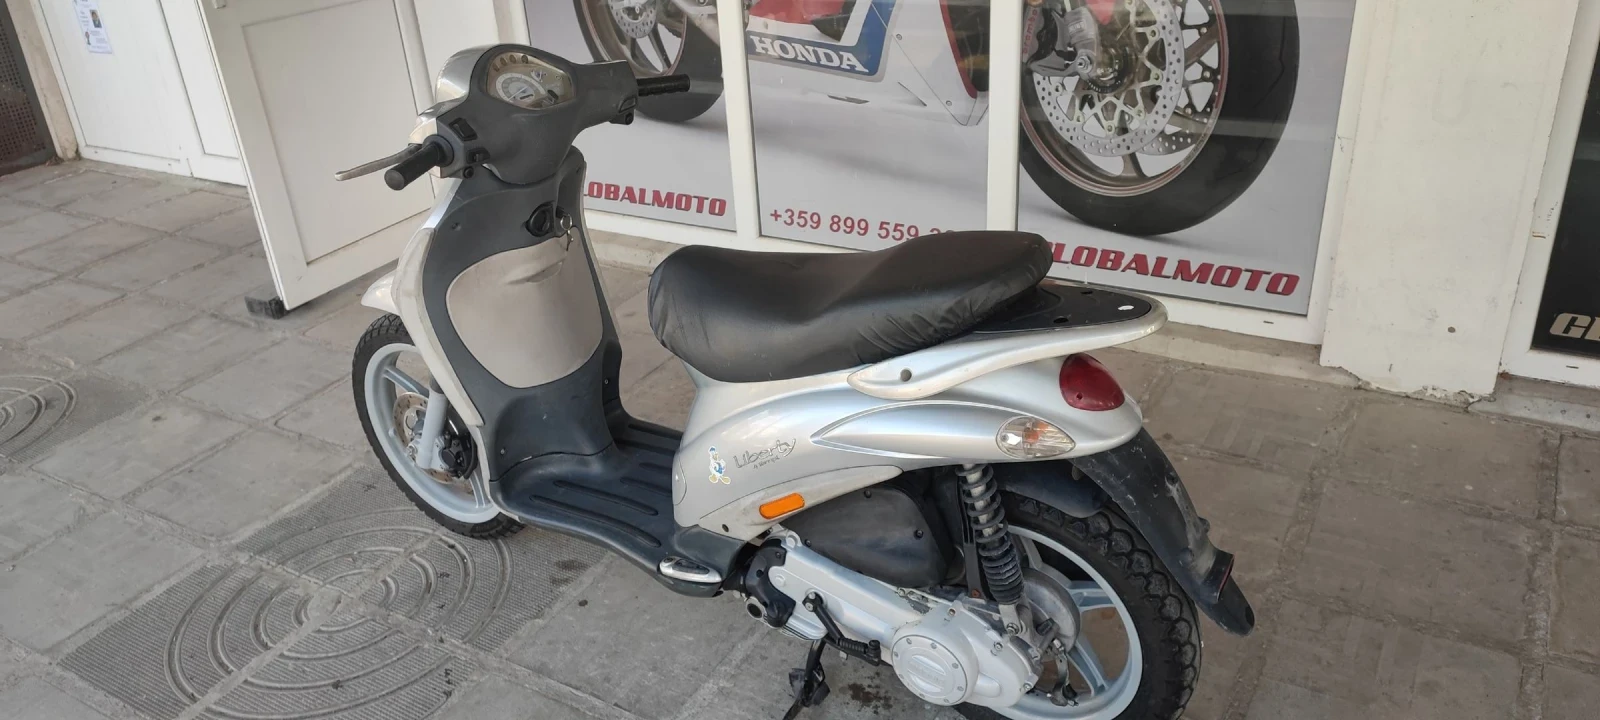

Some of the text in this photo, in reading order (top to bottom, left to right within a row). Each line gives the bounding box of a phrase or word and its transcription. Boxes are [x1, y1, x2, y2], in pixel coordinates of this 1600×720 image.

[749, 35, 869, 73] HONDA
[584, 181, 727, 217] OBALMOTO
[770, 208, 822, 230] +359
[829, 214, 869, 237] 899
[877, 220, 920, 242] 559
[1047, 242, 1301, 296] LOBALMOTO
[732, 438, 797, 469] Liberty
